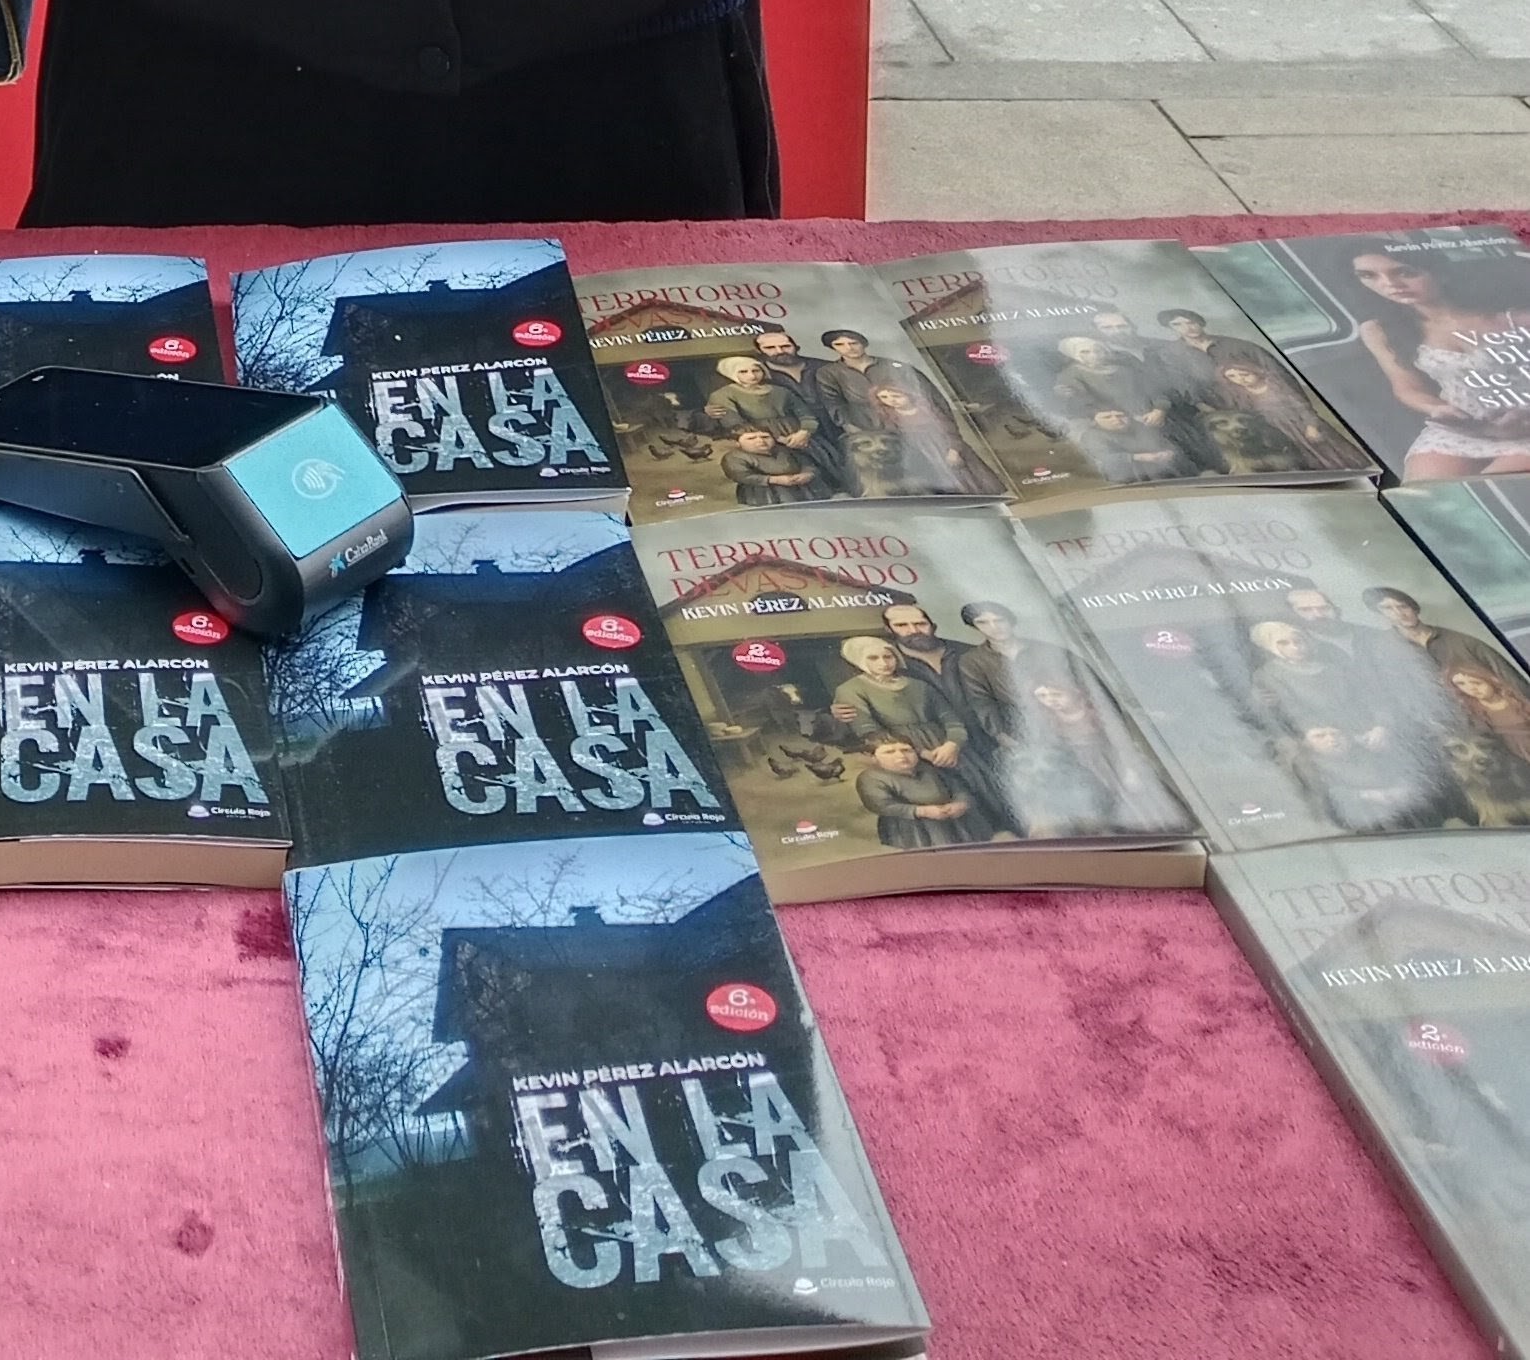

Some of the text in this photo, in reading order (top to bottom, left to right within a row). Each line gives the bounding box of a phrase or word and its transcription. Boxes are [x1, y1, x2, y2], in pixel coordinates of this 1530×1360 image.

[1384, 242, 1421, 252] Kevin
[635, 329, 689, 343] PÉREZ
[691, 323, 765, 339] ALARCÓN
[918, 316, 968, 331] KEVIN
[371, 367, 418, 380] KEVIN
[473, 357, 548, 371] ALARCÓN
[370, 367, 568, 427] EN LA
[375, 406, 609, 475] CASA
[657, 534, 910, 573] TERRITORIO
[670, 562, 919, 600] DEVASTADO
[1082, 590, 1141, 609] KEVIN
[680, 590, 895, 621] KEVIN PÉREZ ALARCÓN
[4, 657, 209, 674] KEVIN PÉREZ ALARCÓN
[421, 662, 630, 687] KEVIN PÉREZ ALARCÓN
[0, 672, 238, 731] EN LA
[423, 677, 661, 745] EN LA
[0, 725, 270, 804] CASA
[435, 729, 721, 815] CASA
[1321, 955, 1530, 988] KEVIN PÉREZ ALAR
[710, 1004, 768, 1022] edición
[512, 1051, 766, 1093] KEVIN PÉREZ ALARCÓN
[514, 1071, 818, 1179] EN LA
[532, 1150, 888, 1289] CASA
